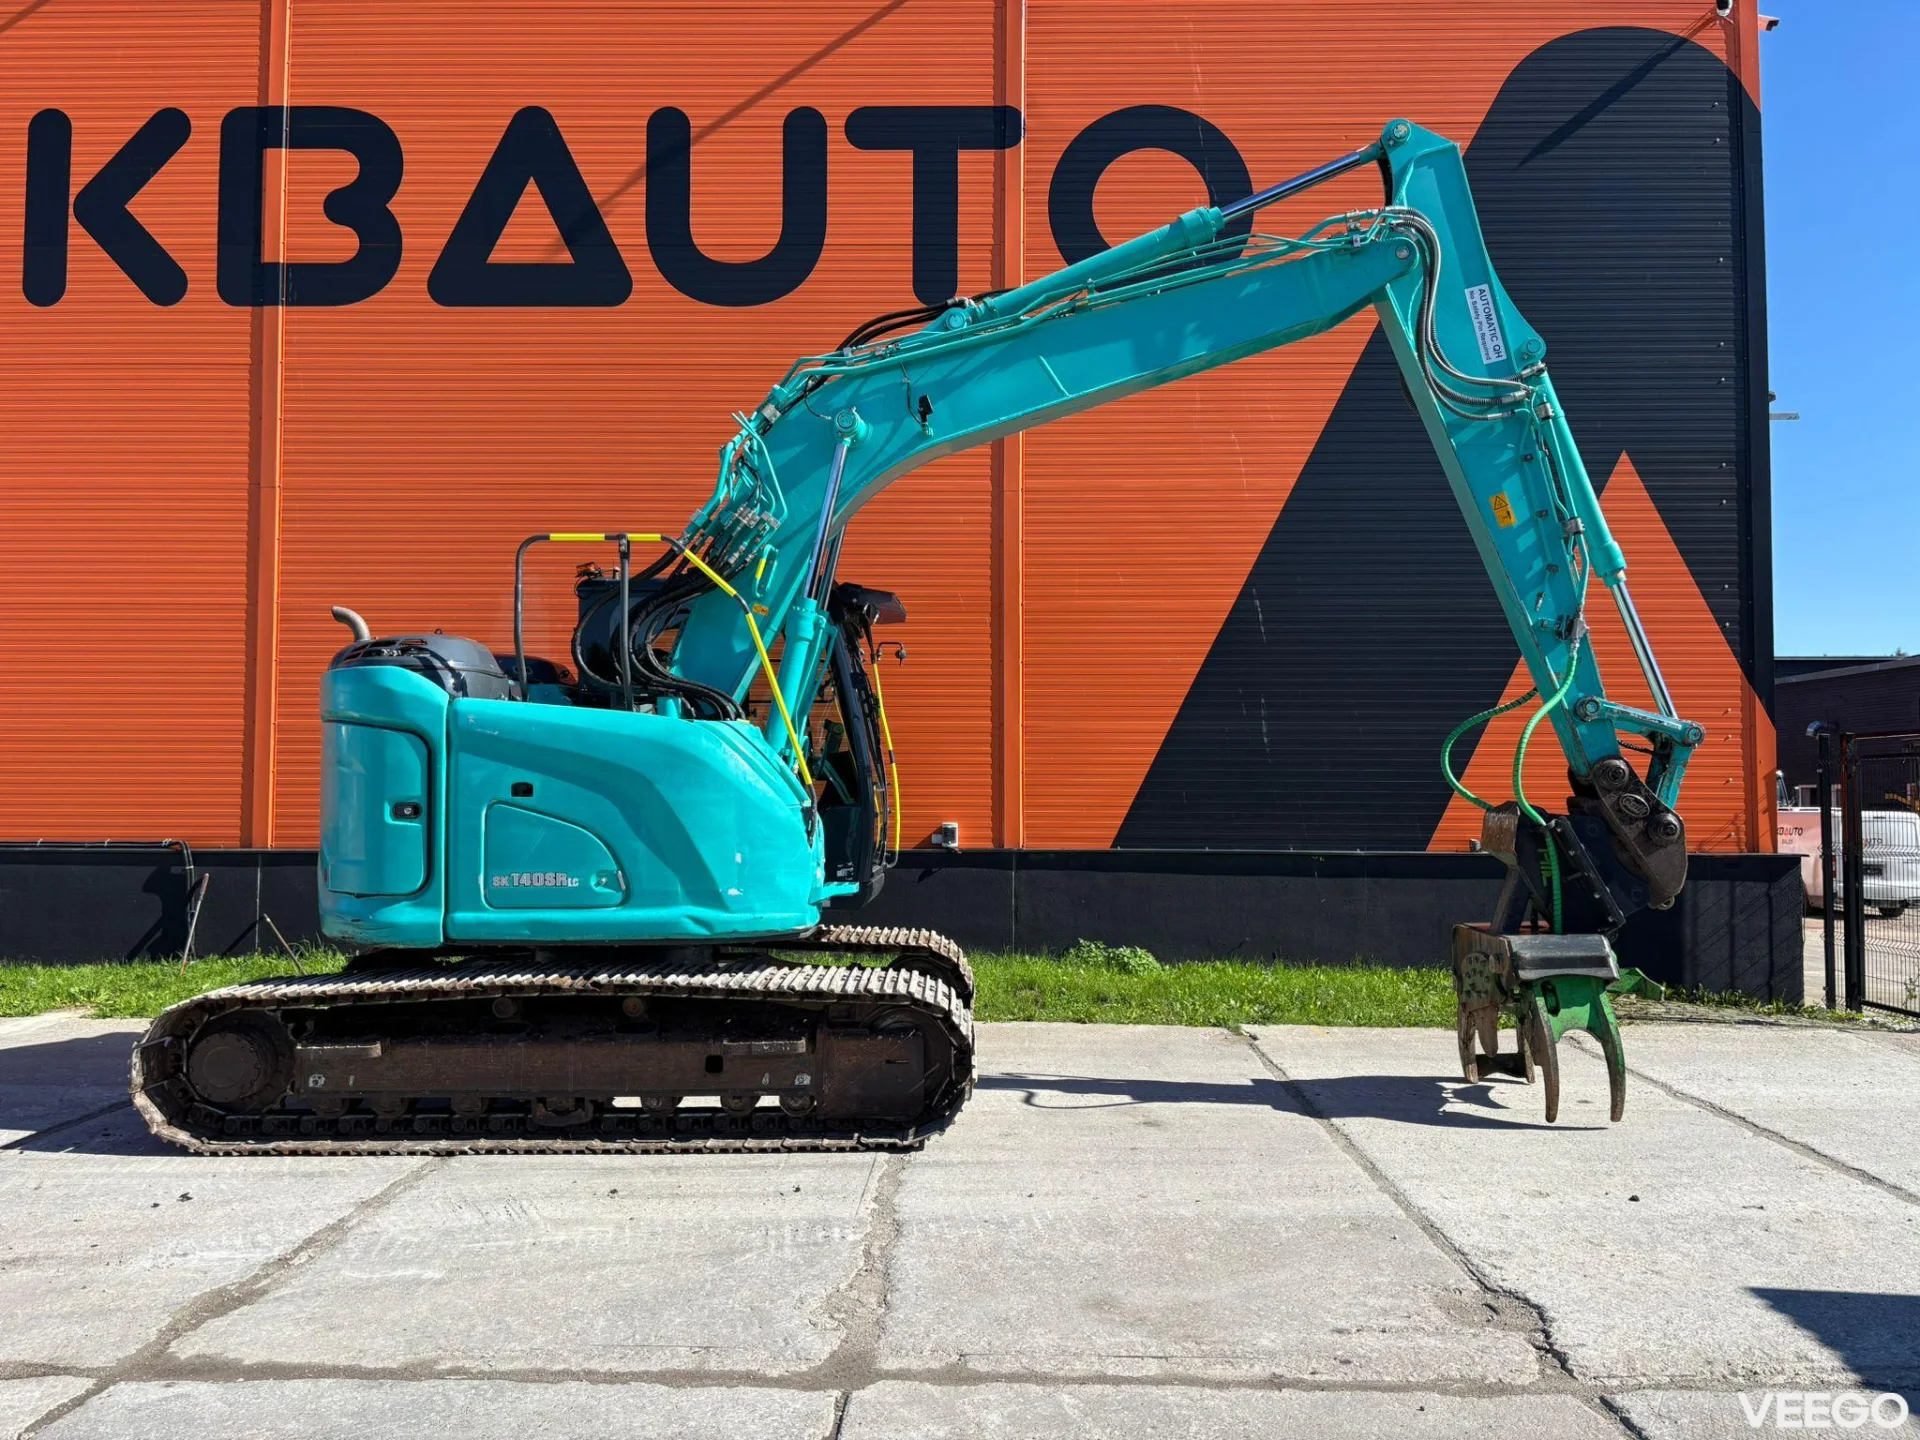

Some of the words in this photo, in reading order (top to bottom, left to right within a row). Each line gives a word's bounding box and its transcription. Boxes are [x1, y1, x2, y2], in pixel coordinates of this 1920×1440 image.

[22, 104, 1255, 308] KBAUTO
[1469, 290, 1476, 300] No
[1472, 300, 1480, 320] Safety
[1478, 288, 1499, 342] AUTOMATIC
[1493, 344, 1503, 359] QH
[1480, 332, 1491, 361] Required
